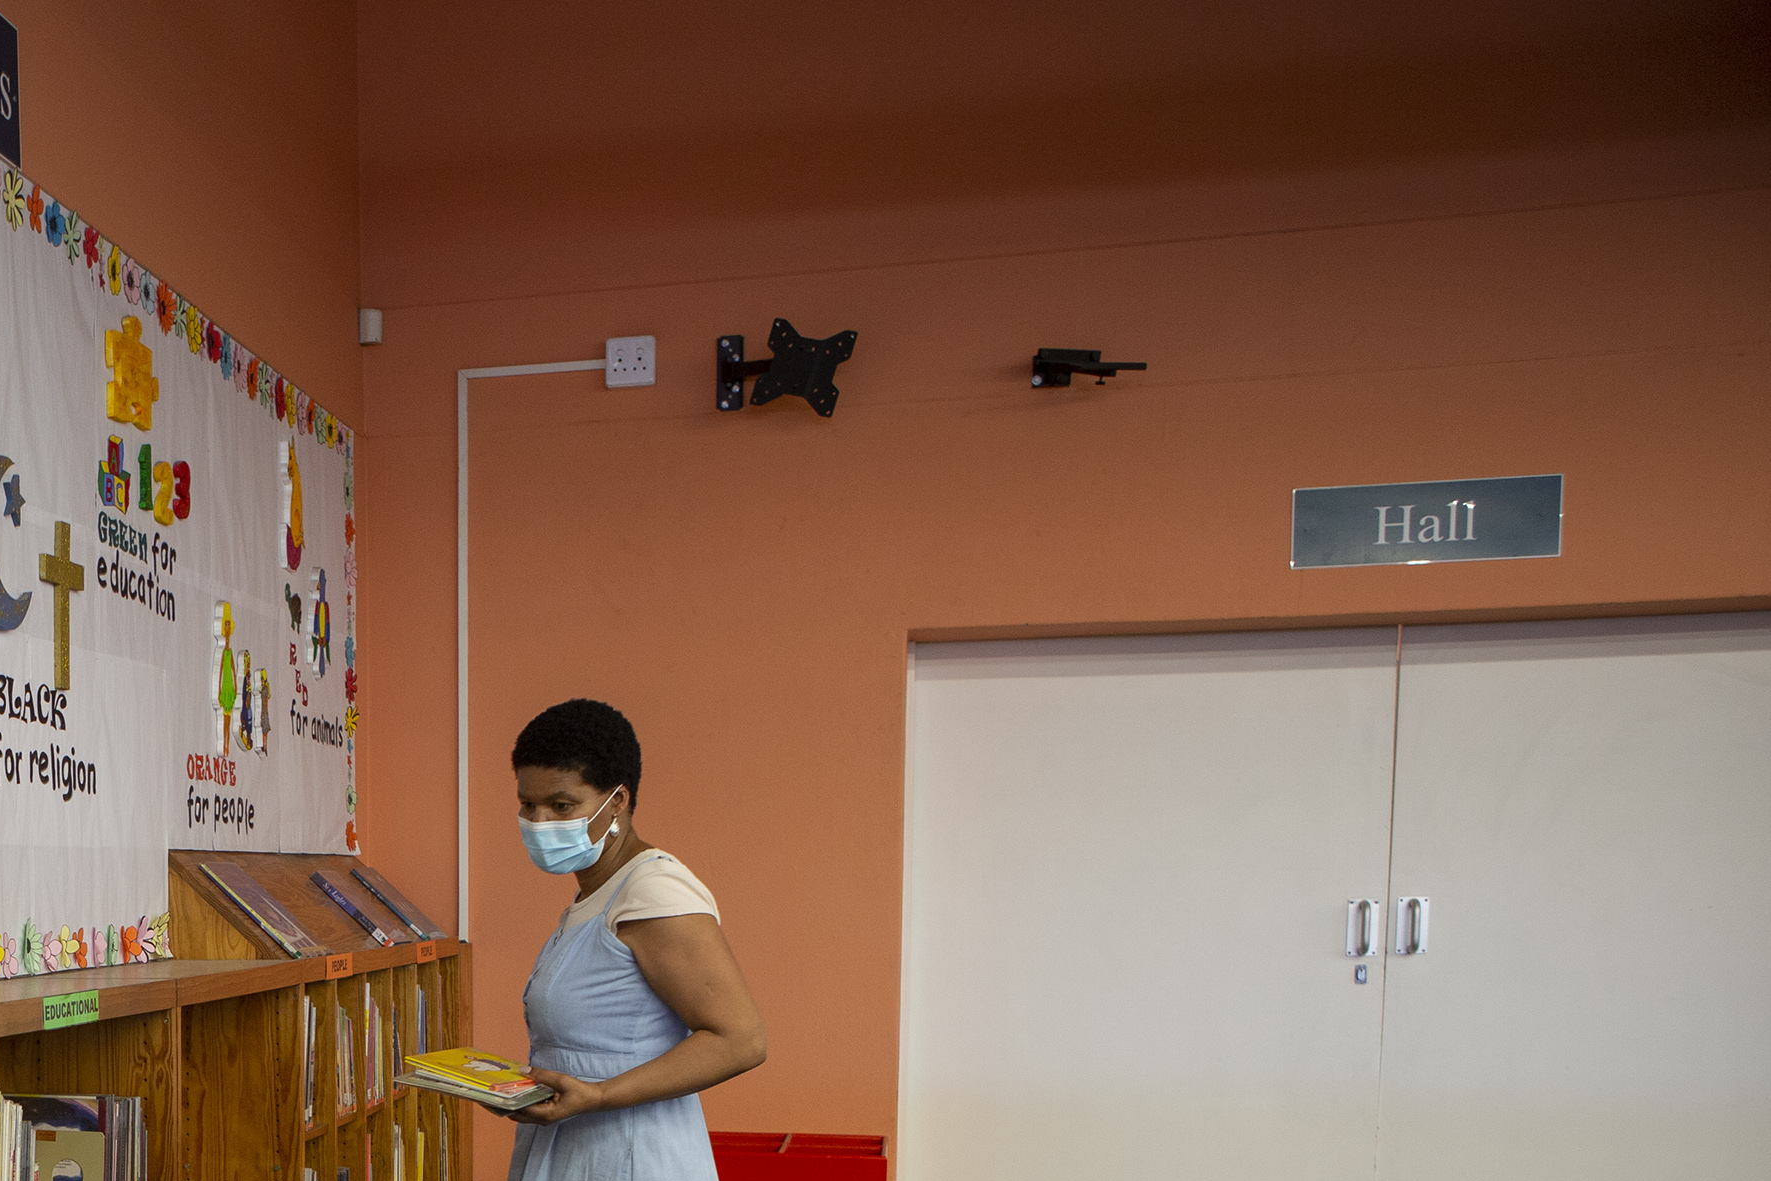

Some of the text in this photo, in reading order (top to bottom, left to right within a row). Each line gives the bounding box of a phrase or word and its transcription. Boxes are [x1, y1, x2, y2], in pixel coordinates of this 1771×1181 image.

[137, 443, 192, 526] 123
[97, 510, 178, 576] GREEN for
[1372, 499, 1477, 546] Hall
[96, 549, 177, 622] education
[288, 641, 309, 707] RED
[289, 698, 344, 749] for animals
[29, 743, 97, 802] religion
[186, 752, 237, 787] ORANGE
[187, 785, 255, 836] for people
[331, 958, 348, 973] PEOPLE
[45, 997, 99, 1021] EDUCATIONAL
